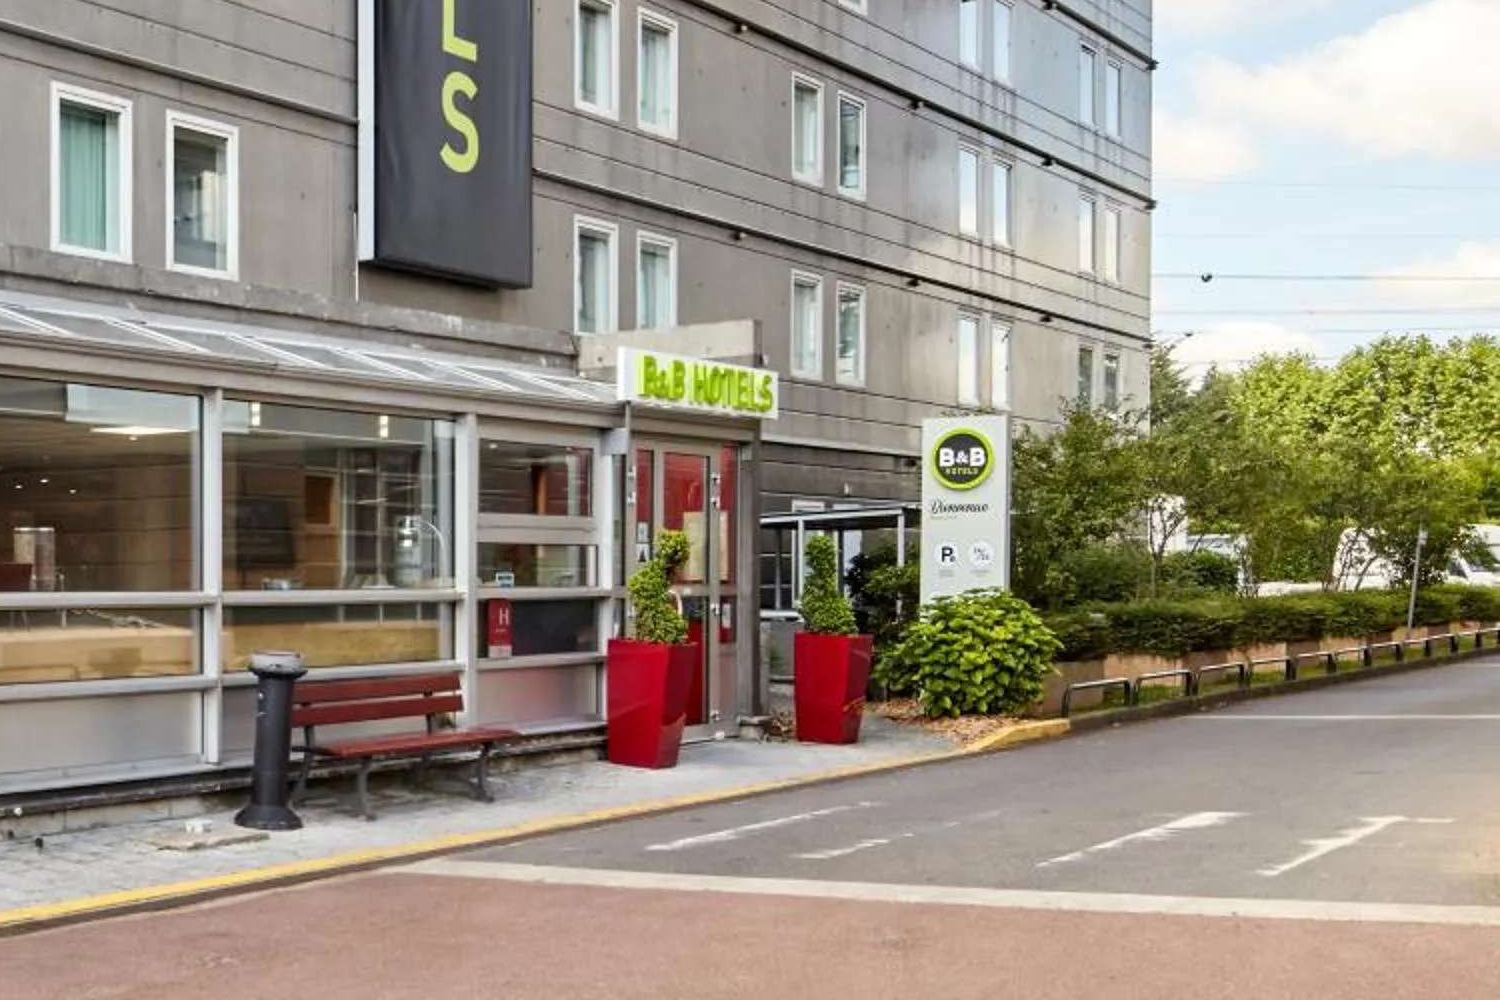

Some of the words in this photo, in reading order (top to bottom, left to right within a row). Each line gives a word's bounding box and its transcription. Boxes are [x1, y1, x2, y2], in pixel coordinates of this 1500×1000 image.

[637, 355, 685, 401] B&B
[689, 361, 773, 413] HOTELS
[939, 447, 986, 467] B&B
[941, 546, 953, 562] P
[499, 607, 509, 626] H
